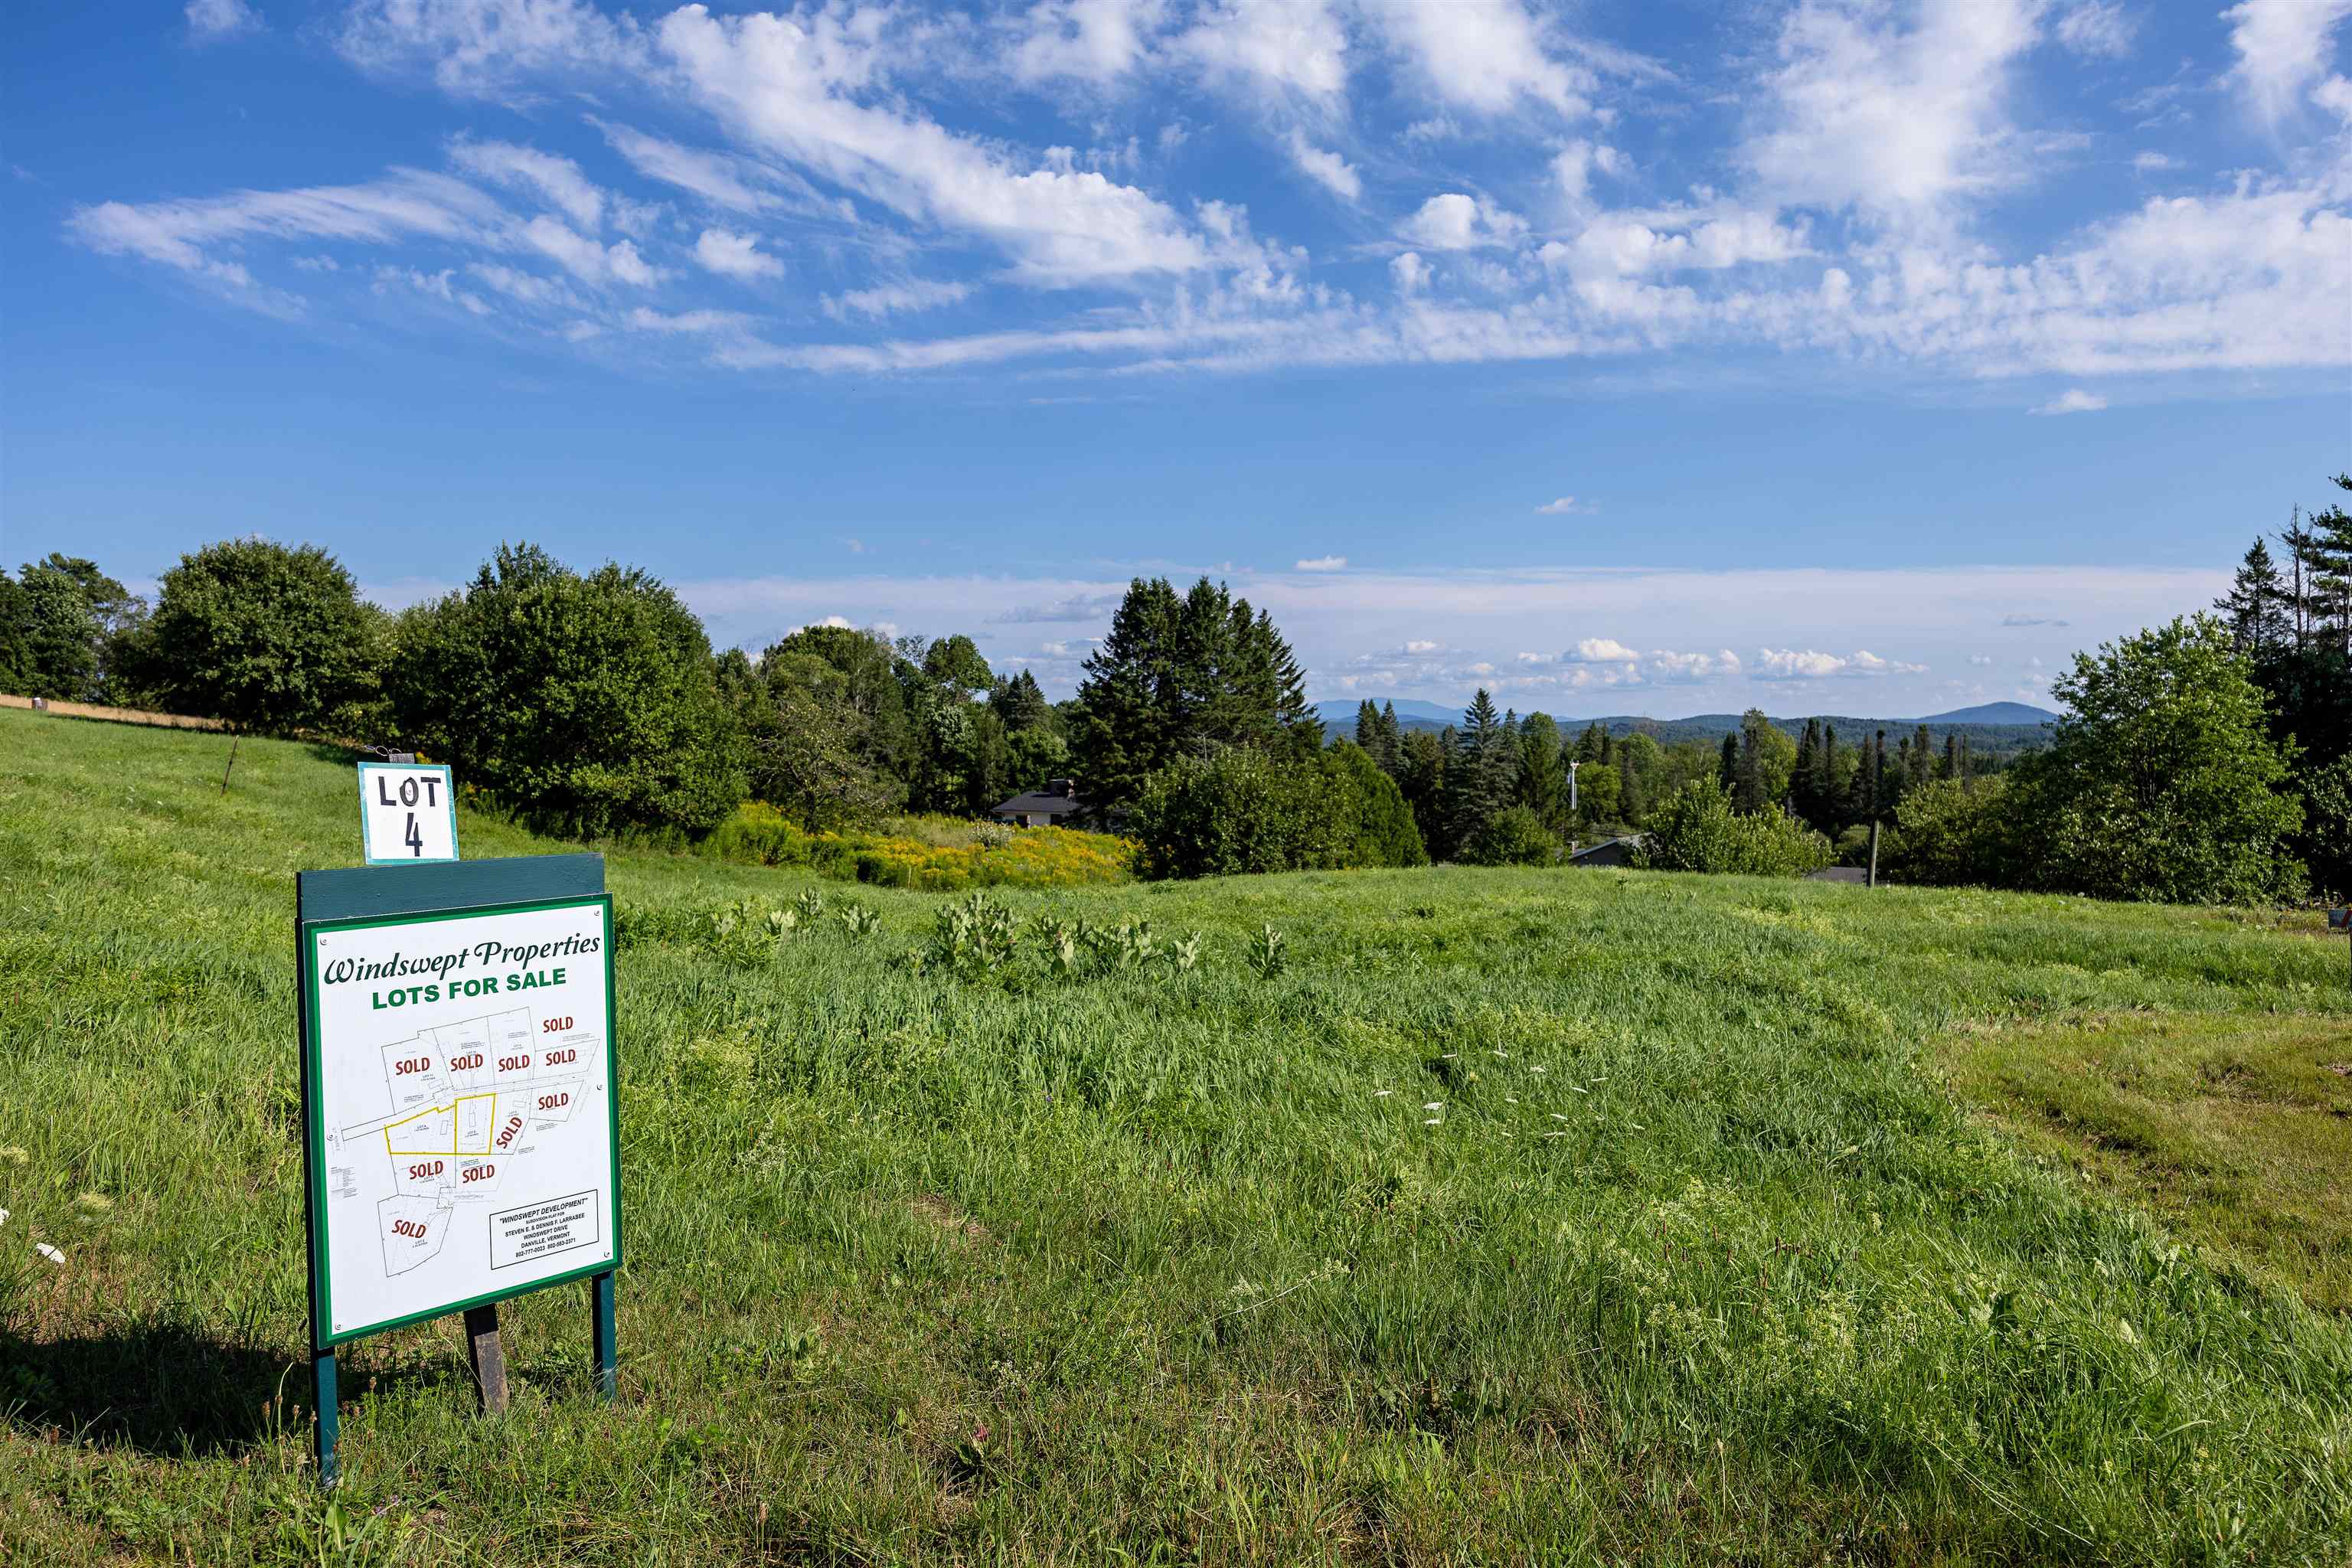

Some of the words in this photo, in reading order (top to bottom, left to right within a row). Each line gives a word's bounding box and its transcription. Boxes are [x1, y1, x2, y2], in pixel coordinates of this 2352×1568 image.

[377, 776, 442, 807] LOT
[405, 812, 423, 857] 4
[324, 948, 470, 985] Windswept
[473, 933, 600, 971] Properties
[372, 985, 440, 1010] LOTS
[449, 977, 499, 1000] FOR
[506, 968, 567, 991] SALE
[543, 1016, 573, 1033] SOLD
[395, 1057, 430, 1075] SOLD
[450, 1054, 484, 1072] SOLD
[498, 1054, 530, 1072] SOLD
[546, 1050, 576, 1067] SOLD
[538, 1093, 569, 1110] SOLD
[496, 1116, 522, 1148] SOLD
[409, 1160, 444, 1180] SOLD
[462, 1164, 495, 1184] SOLD
[499, 1209, 541, 1223] "WINDSWEPT
[541, 1197, 588, 1214] DEVELOPMENT"
[391, 1219, 426, 1239] SOLD
[505, 1228, 524, 1236] STEVEN
[536, 1220, 554, 1229] DENNIS
[560, 1213, 585, 1223] LARRABEE
[524, 1229, 553, 1240] WINDSWEPT
[554, 1224, 568, 1233] DRIVE
[521, 1237, 546, 1248] DANVILLE,
[547, 1231, 570, 1241] VERMONT
